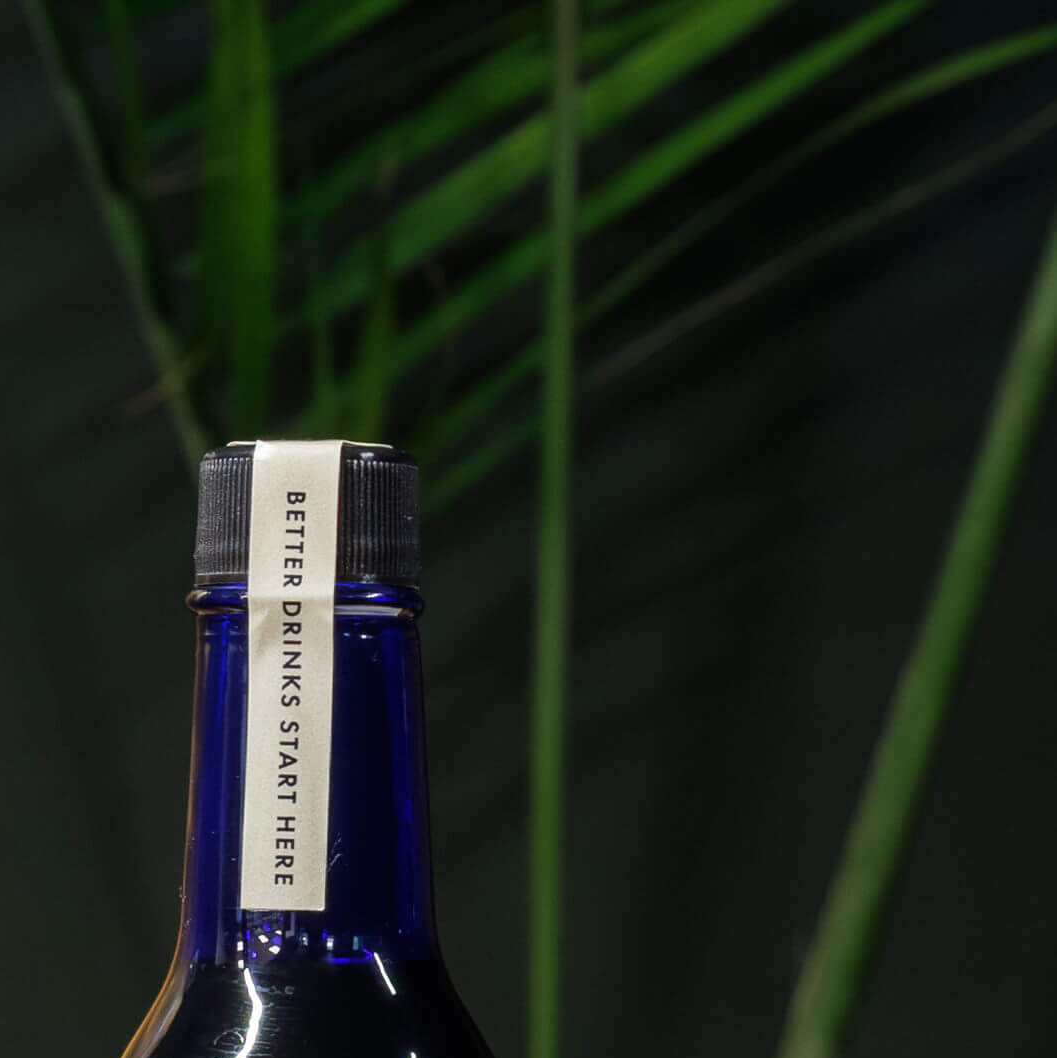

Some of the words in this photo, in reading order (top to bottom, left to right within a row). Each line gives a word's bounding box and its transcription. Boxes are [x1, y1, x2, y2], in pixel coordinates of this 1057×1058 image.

[282, 491, 307, 588] BETTER
[280, 600, 302, 708] DRINKS
[276, 720, 300, 804] START
[274, 815, 295, 887] HERE
